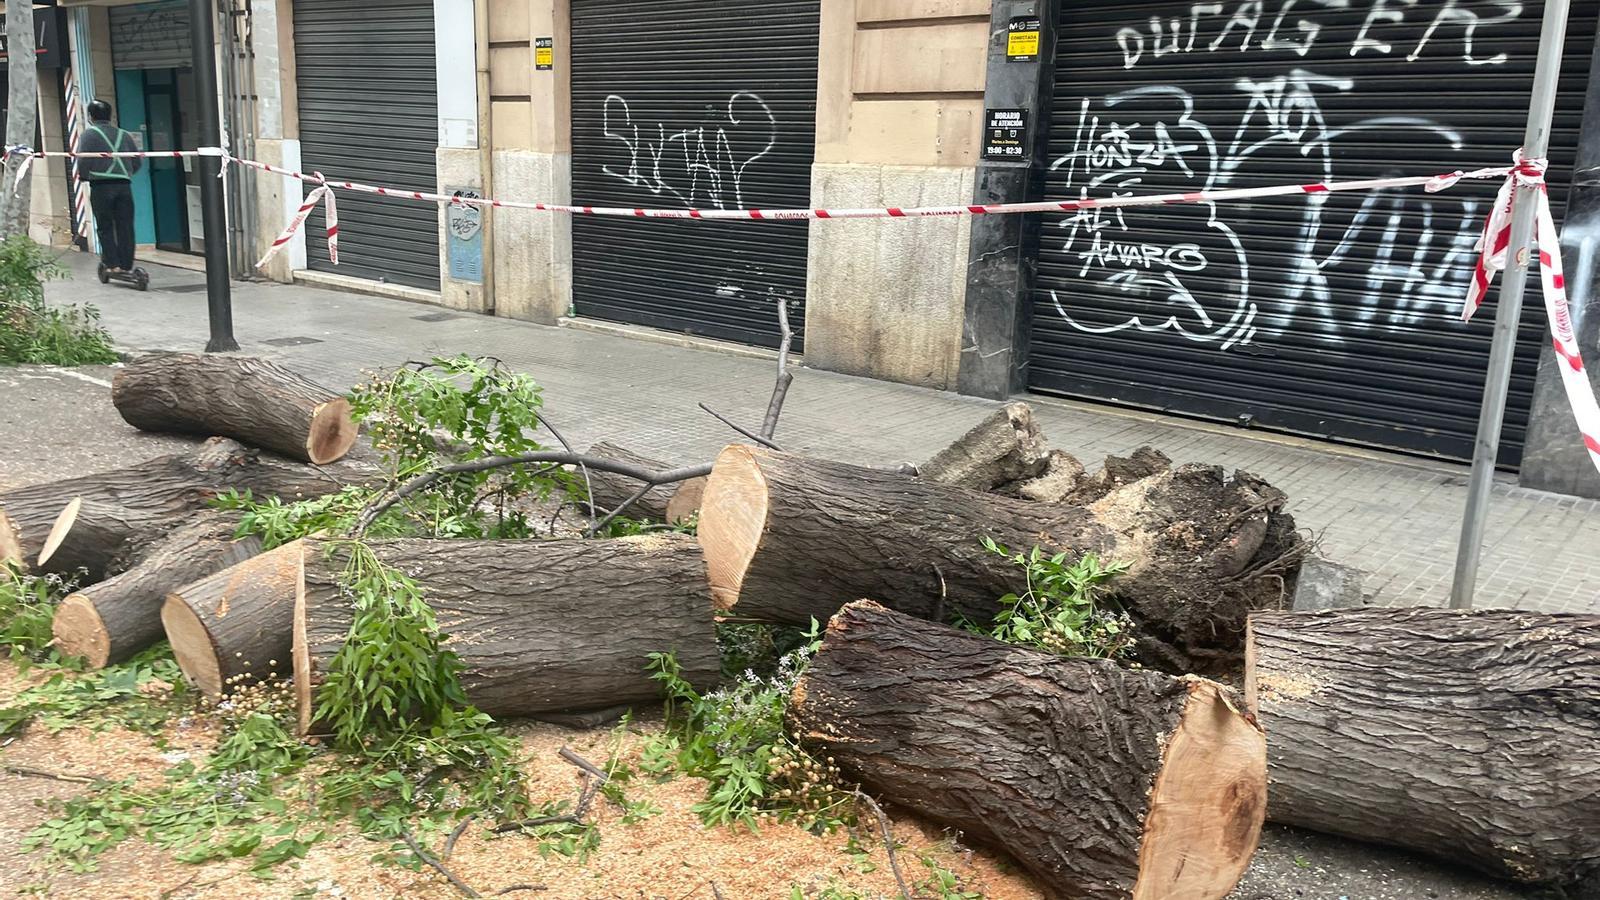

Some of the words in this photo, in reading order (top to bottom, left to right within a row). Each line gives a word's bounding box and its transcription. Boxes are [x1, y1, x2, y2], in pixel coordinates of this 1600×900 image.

[994, 112, 1020, 120] HORARIO
[998, 119, 1023, 127] ATENCIÓN
[1051, 98, 1198, 187] HONZA
[987, 146, 1002, 154] 19:00
[1006, 146, 1022, 155] 02:30
[1079, 232, 1208, 277] ALVARO
